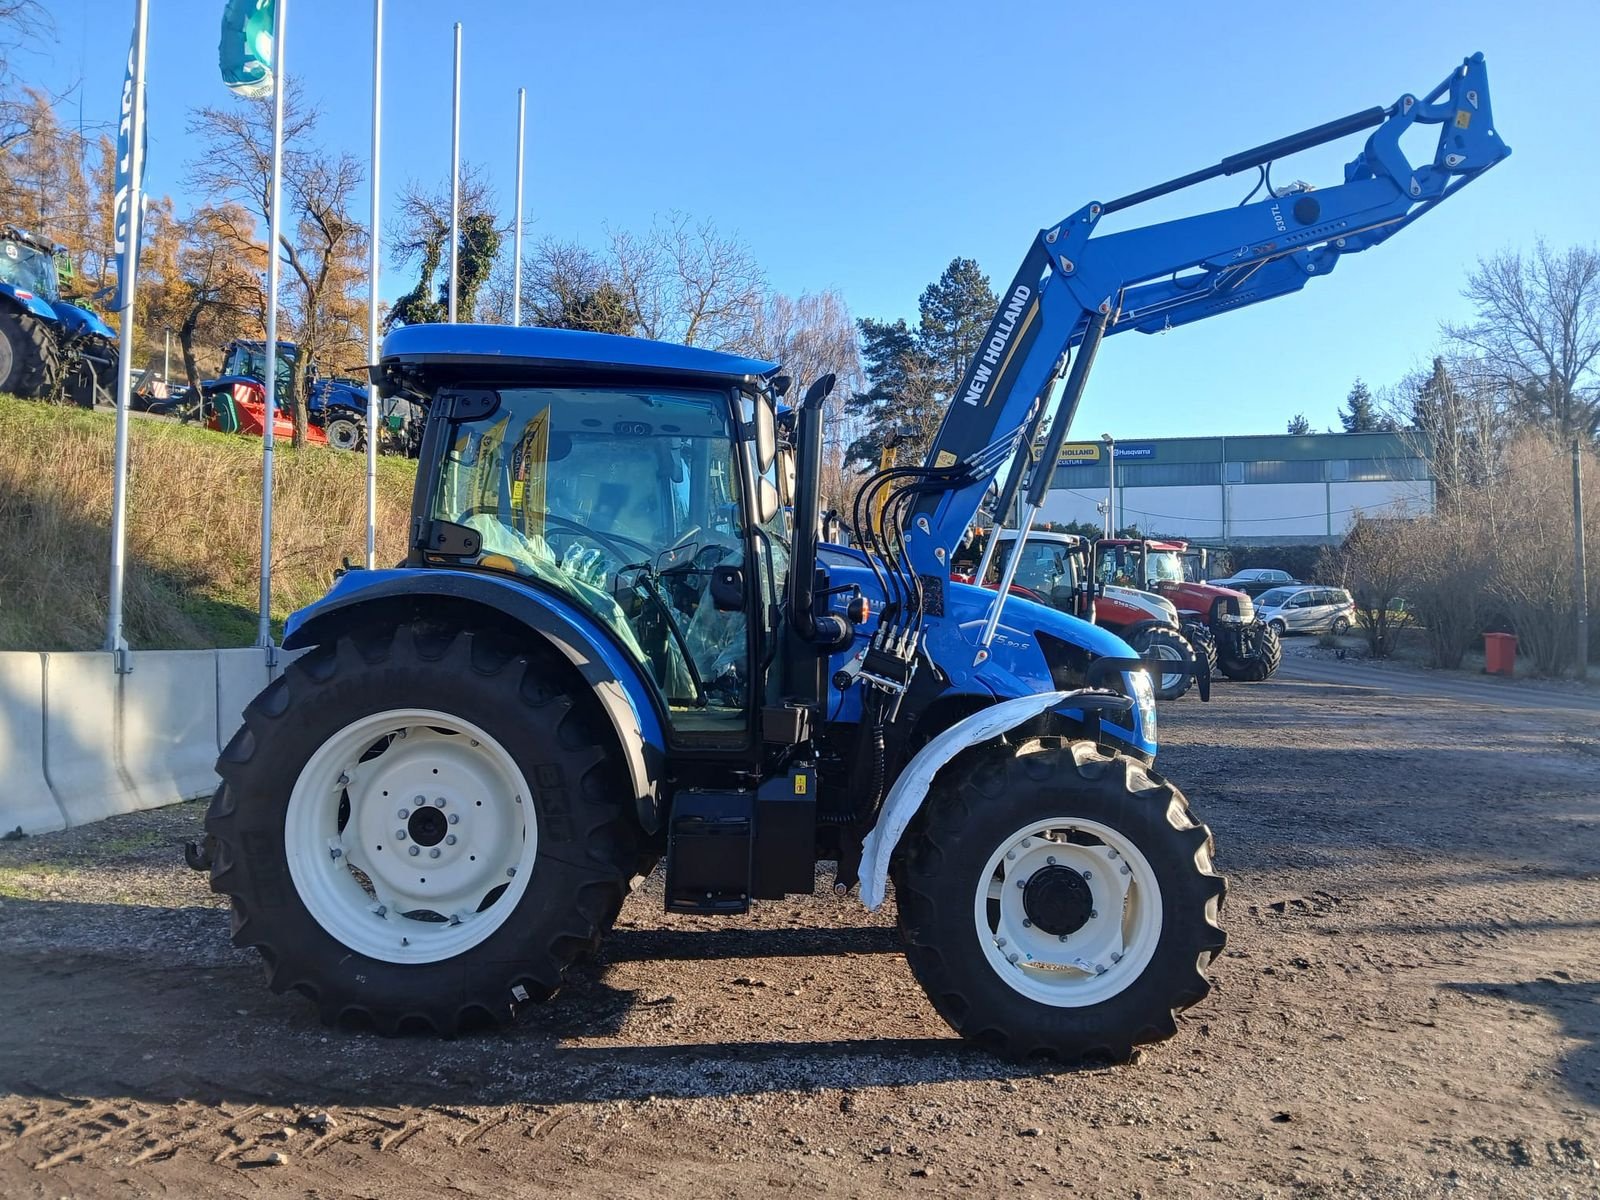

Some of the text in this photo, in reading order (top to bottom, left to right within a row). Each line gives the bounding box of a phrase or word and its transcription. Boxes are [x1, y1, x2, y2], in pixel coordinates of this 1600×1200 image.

[1271, 203, 1287, 232] 530TL
[963, 285, 1031, 407] NEW HOLLAND
[1062, 449, 1094, 457] HOLLAND
